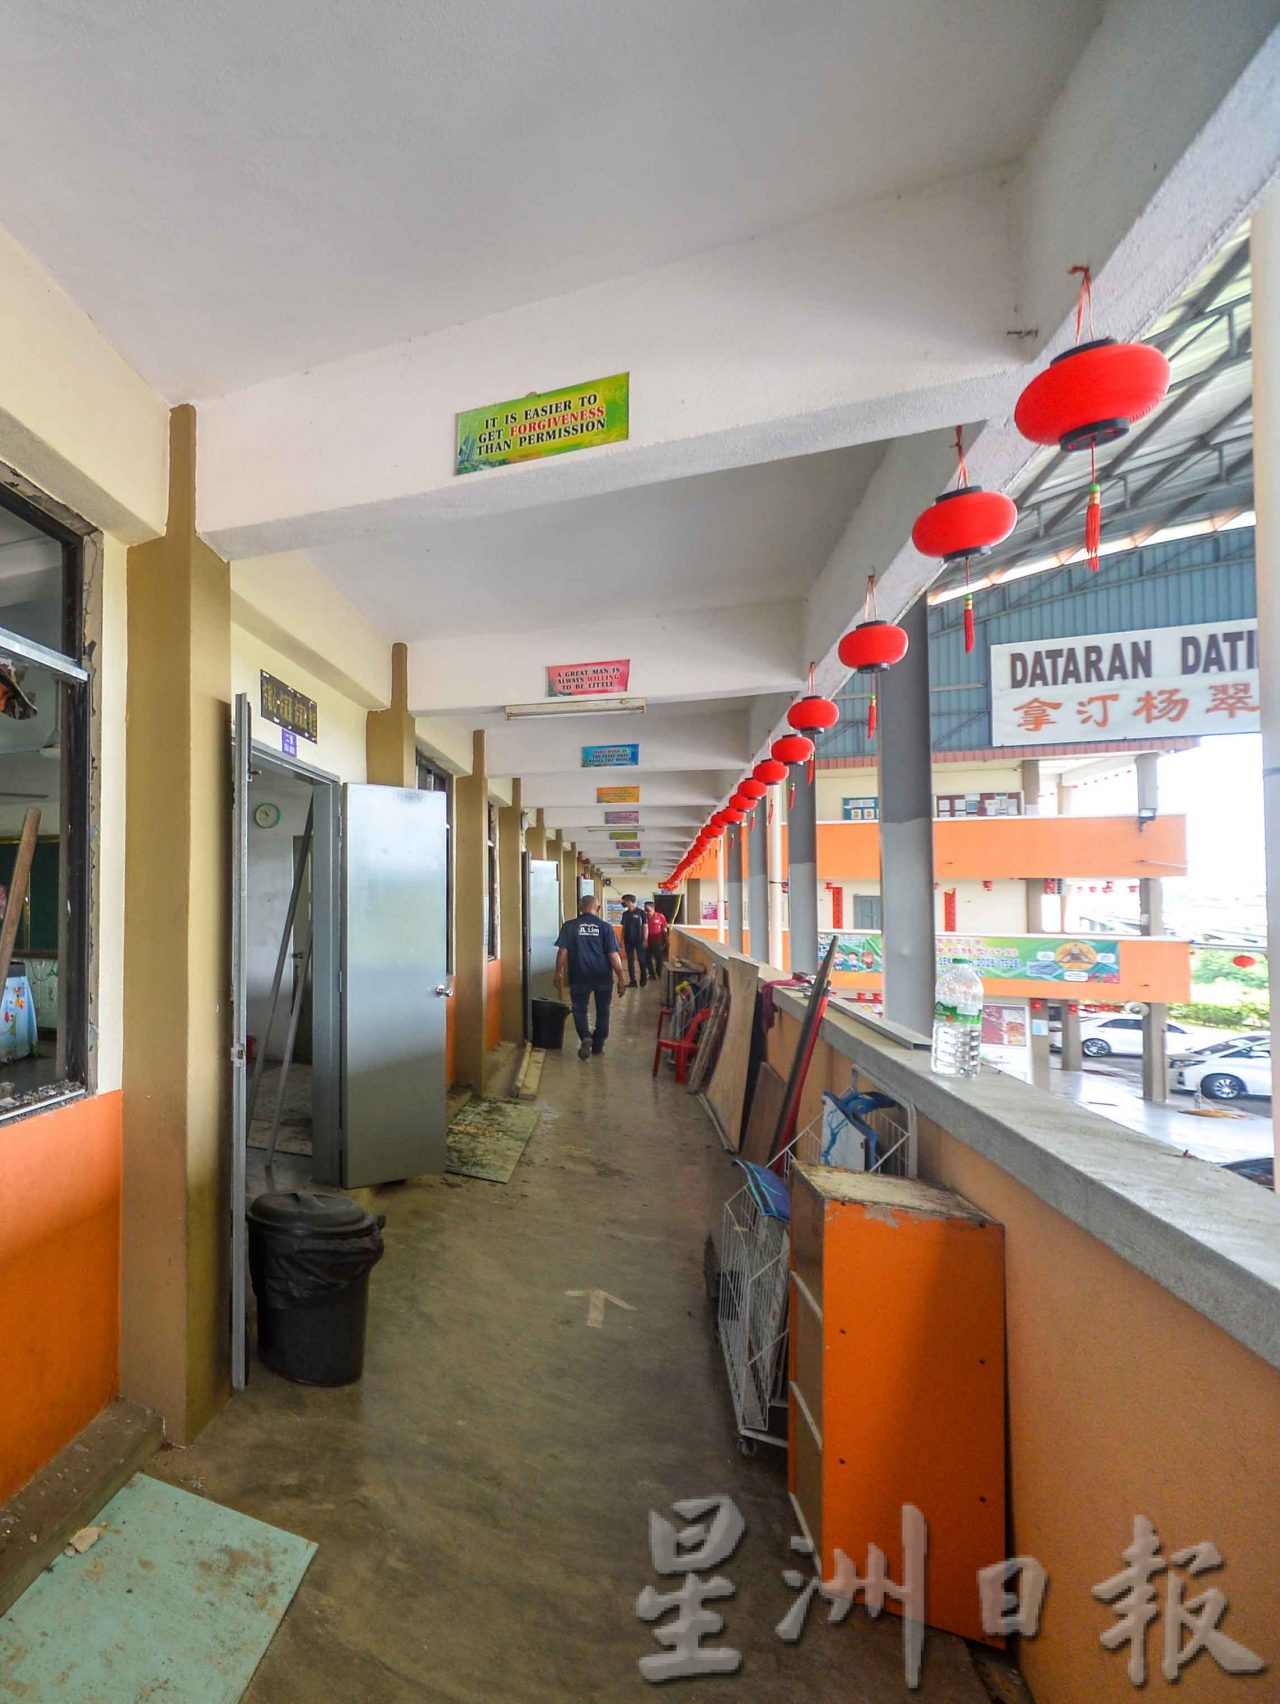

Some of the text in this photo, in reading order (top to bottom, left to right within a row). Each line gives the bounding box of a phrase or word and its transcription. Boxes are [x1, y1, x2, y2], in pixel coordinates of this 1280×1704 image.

[478, 406, 605, 444] GET FORGIVENESS
[485, 394, 597, 430] IT IS EASIER TO
[476, 418, 606, 456] THAN PERMISSION
[565, 669, 588, 678] GREAT
[592, 667, 609, 675] MAN
[1010, 630, 1259, 689] DATARAN DATI
[588, 681, 614, 689] LITTLE
[1013, 682, 1260, 732] 拿汀杨翠
